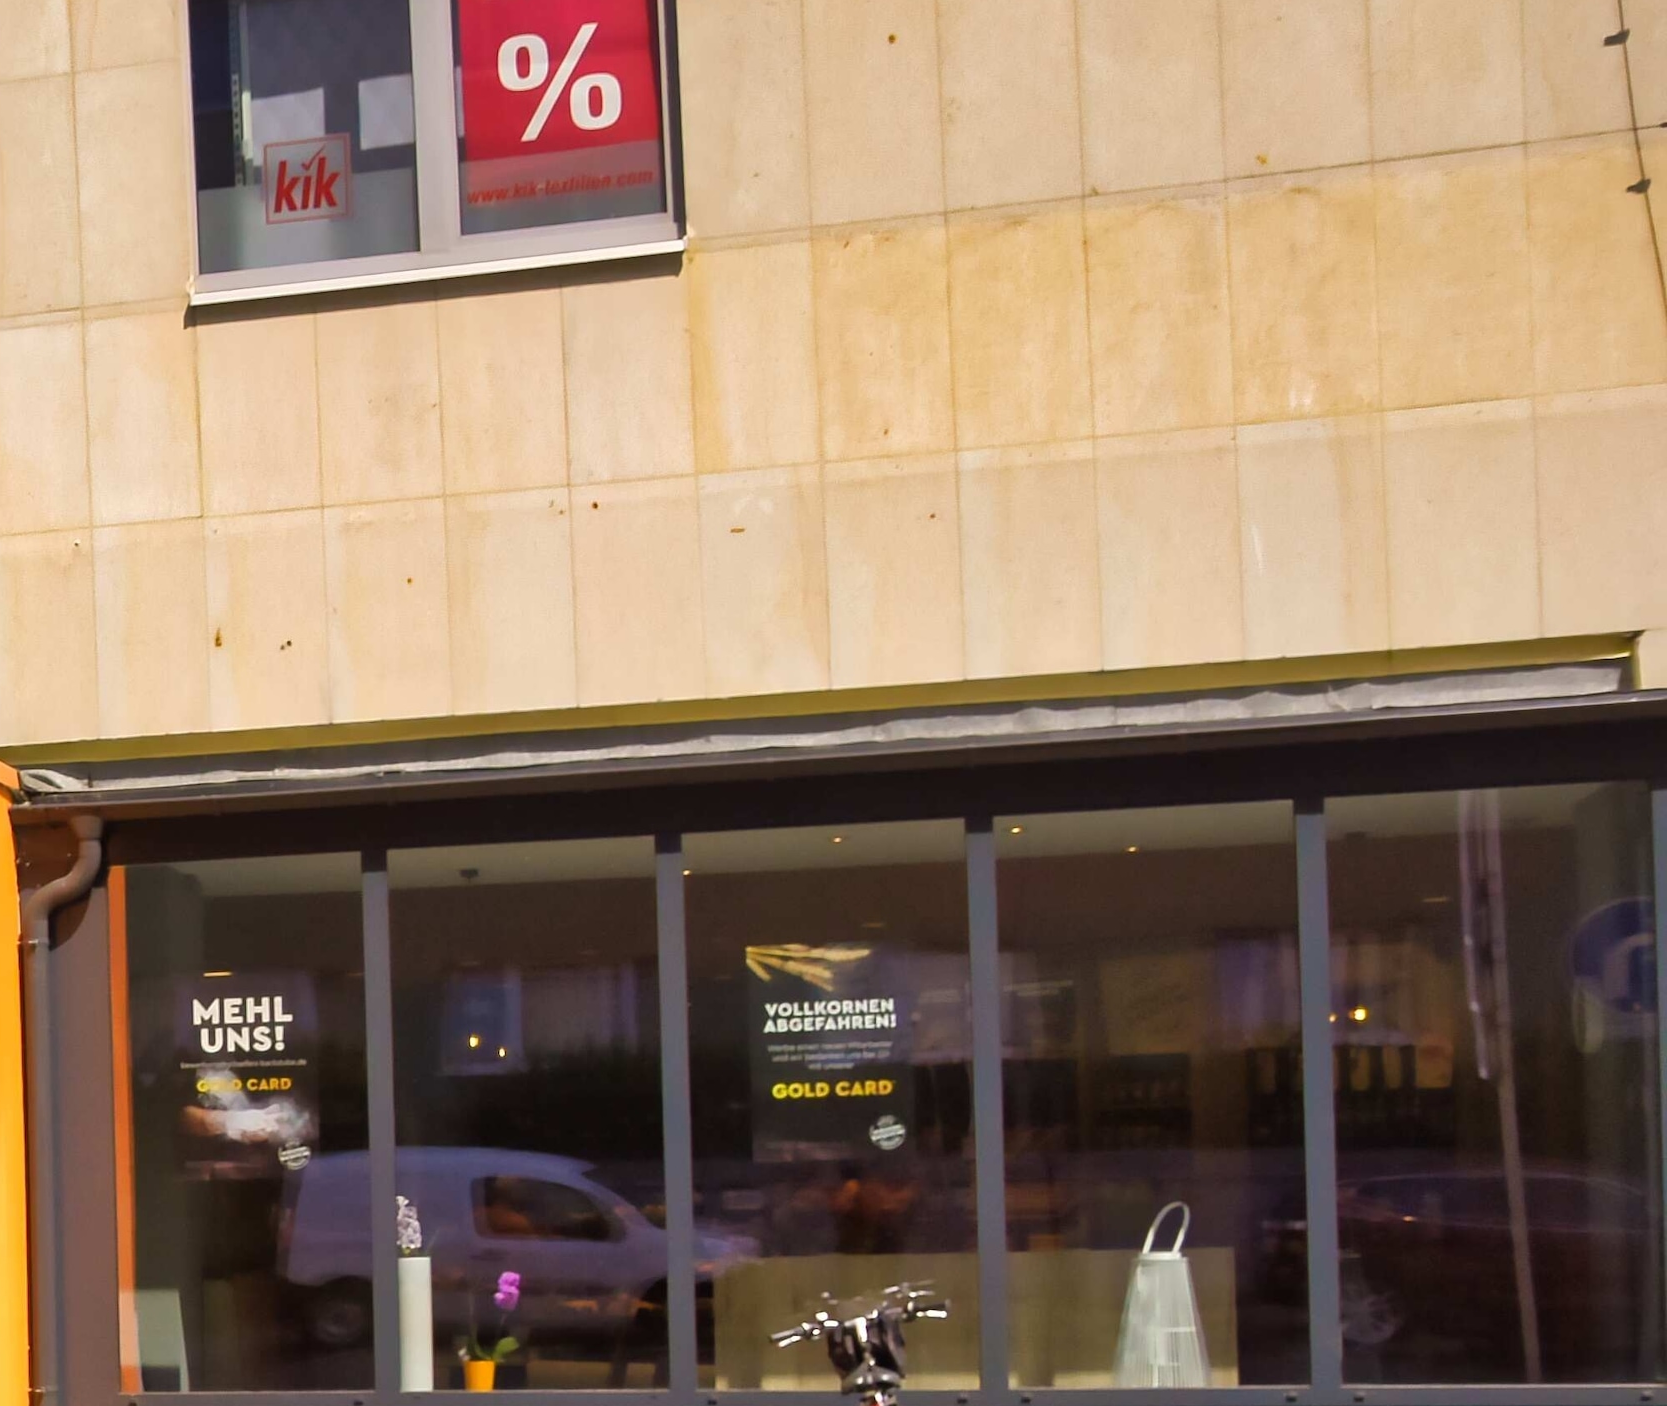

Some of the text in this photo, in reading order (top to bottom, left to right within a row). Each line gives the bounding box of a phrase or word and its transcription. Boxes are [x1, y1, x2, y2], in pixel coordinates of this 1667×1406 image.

[273, 144, 342, 214] kik
[192, 996, 294, 1025] MEHL
[764, 998, 895, 1017] VOLLKORNEN
[763, 1014, 897, 1033] ABGEFAHREN!
[200, 1026, 285, 1053] UNS!
[247, 1077, 293, 1091] CARD
[772, 1079, 893, 1099] GOLD CARD
